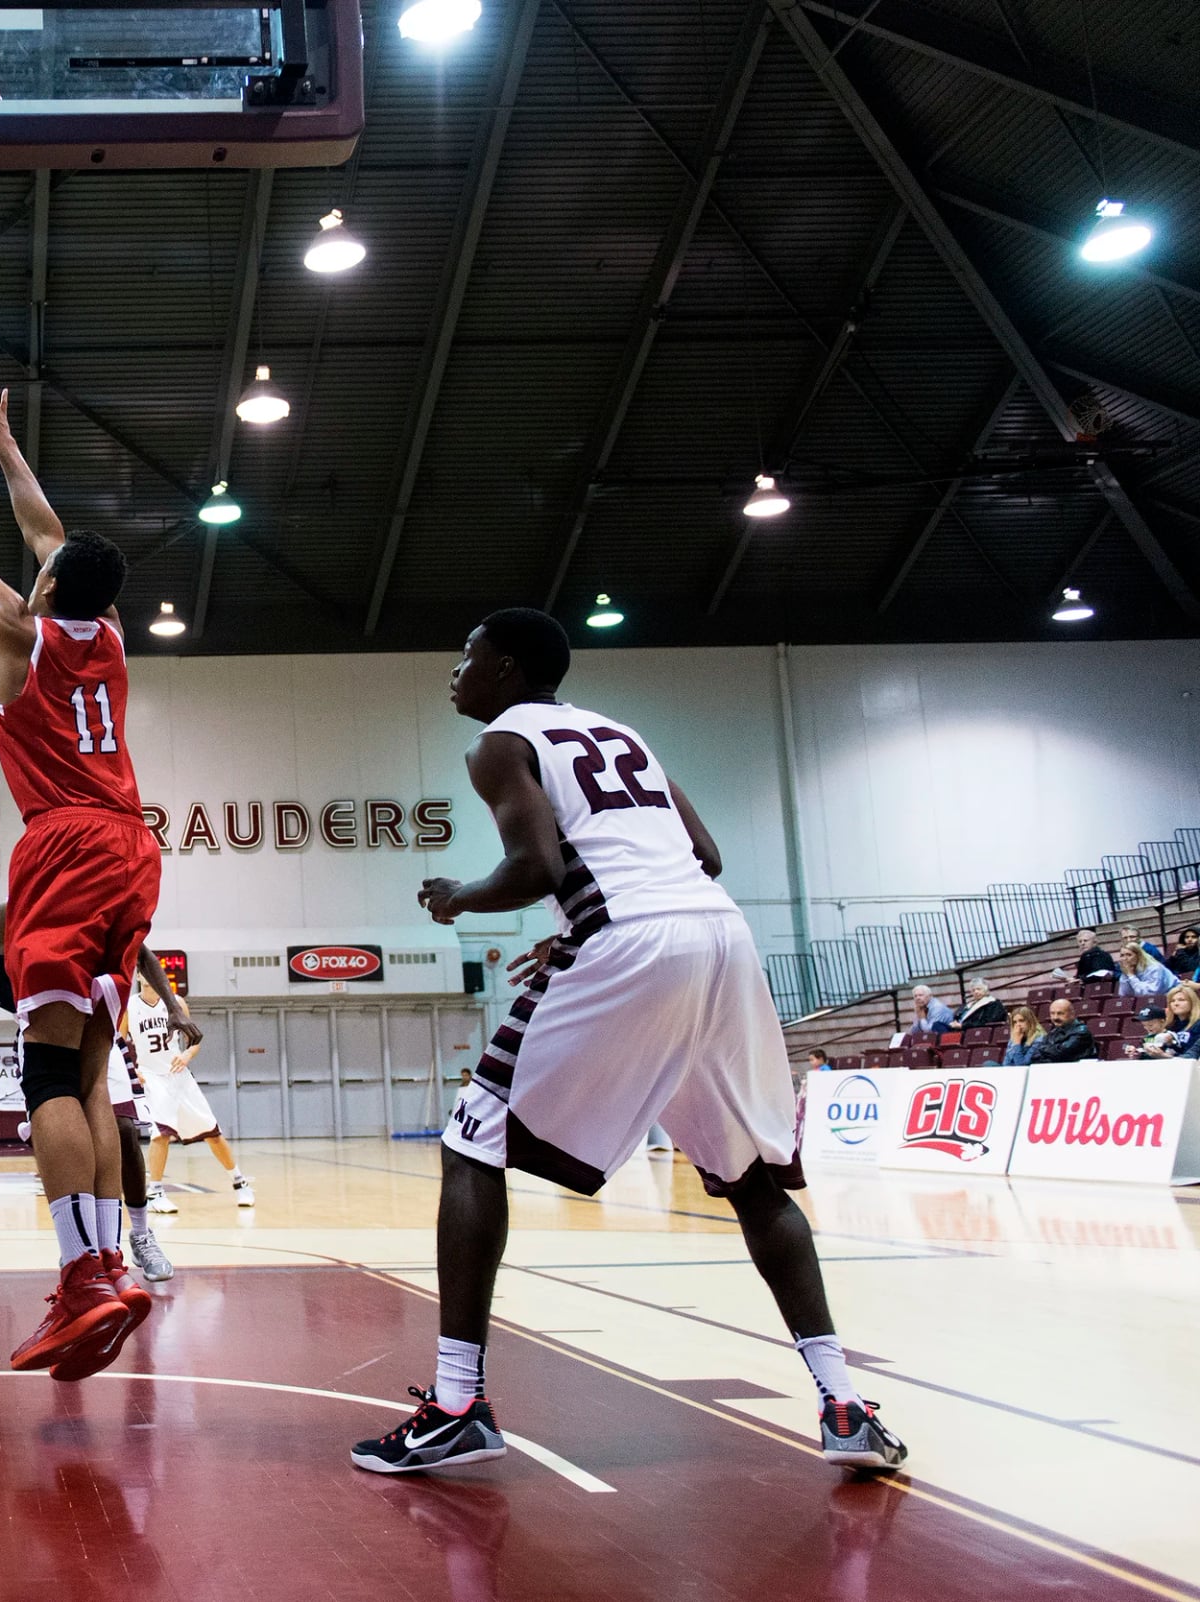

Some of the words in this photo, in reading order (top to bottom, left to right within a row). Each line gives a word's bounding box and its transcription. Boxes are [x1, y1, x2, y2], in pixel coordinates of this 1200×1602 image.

[70, 682, 118, 755] 11
[541, 726, 671, 815] 22
[141, 799, 456, 851] RAUDERS
[158, 956, 185, 970] :44
[321, 956, 348, 969] FOX
[348, 955, 368, 969] 40
[139, 1017, 168, 1034] MCMAST
[827, 1103, 879, 1121] OUA
[903, 1080, 997, 1141] CIS
[1027, 1096, 1164, 1147] Wilson
